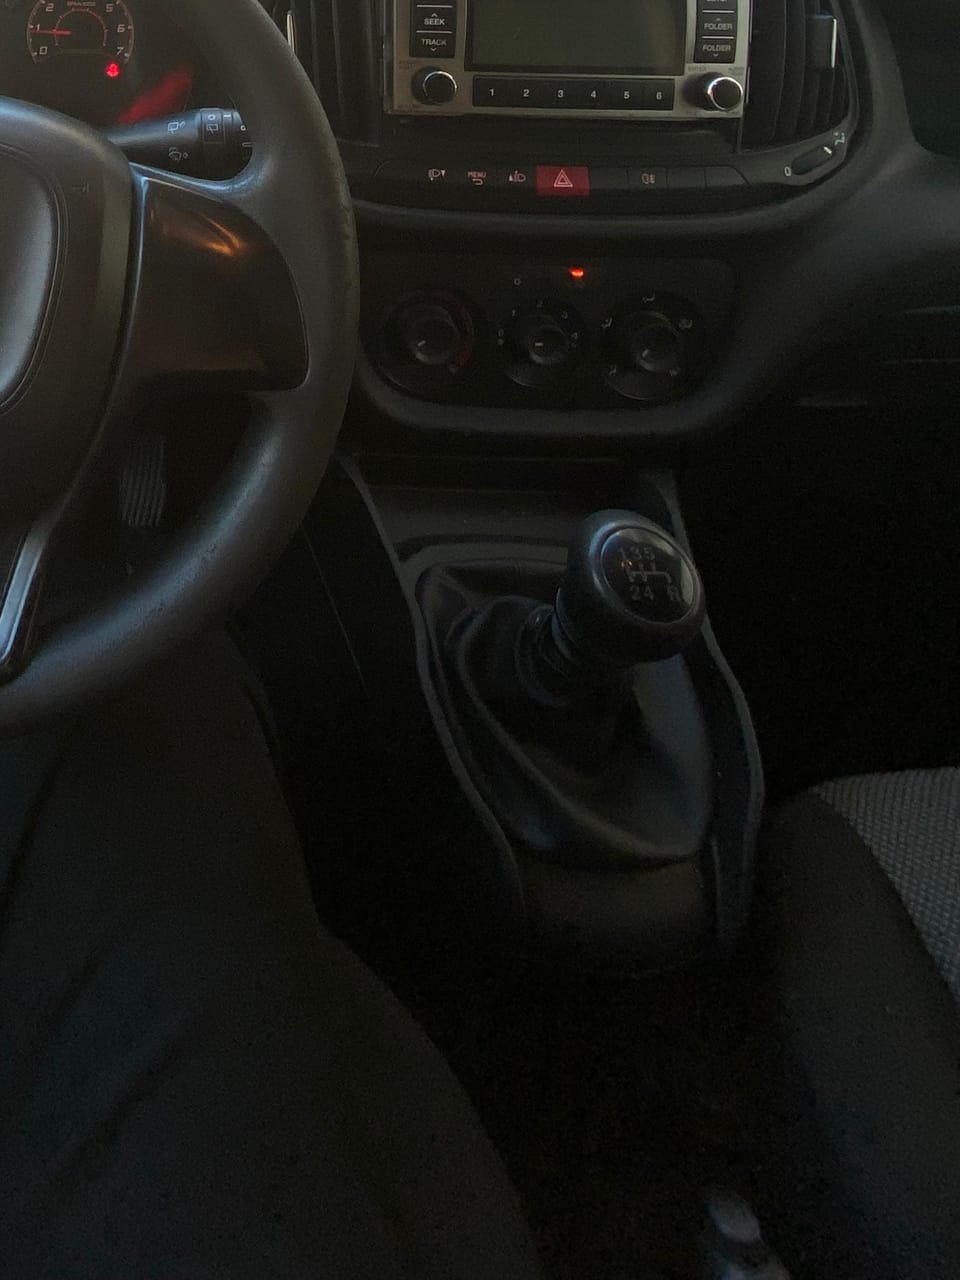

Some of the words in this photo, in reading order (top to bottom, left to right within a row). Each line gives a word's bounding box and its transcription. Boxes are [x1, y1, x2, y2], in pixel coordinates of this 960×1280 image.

[45, 2, 55, 12] 2
[105, 3, 115, 12] 5
[423, 18, 446, 26] SEEK
[704, 22, 733, 31] FOLDER
[117, 24, 126, 33] 6
[421, 38, 447, 46] TRACK
[39, 45, 49, 55] 0
[116, 46, 126, 55] 7
[702, 44, 731, 52] FOLDER
[523, 89, 530, 98] 2
[557, 89, 564, 98] 3
[590, 90, 597, 99] 4
[623, 91, 630, 100] 5
[655, 91, 663, 100] 6
[467, 171, 487, 180] MENU
